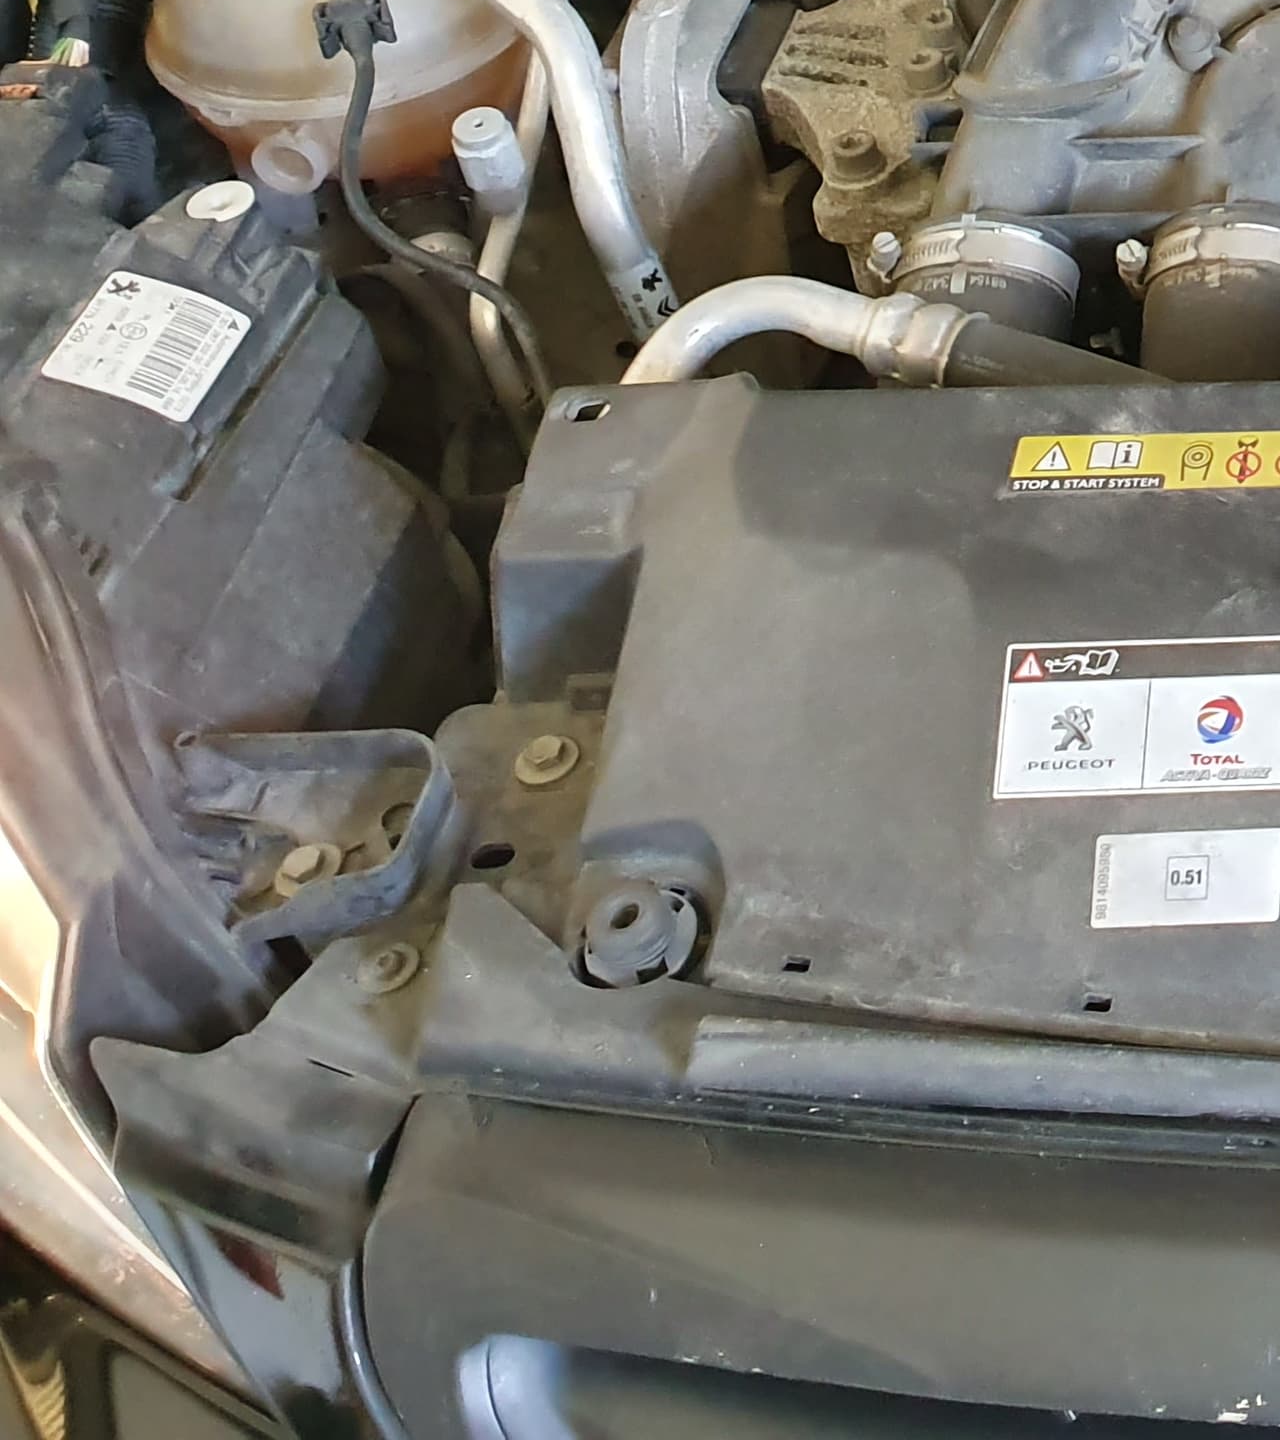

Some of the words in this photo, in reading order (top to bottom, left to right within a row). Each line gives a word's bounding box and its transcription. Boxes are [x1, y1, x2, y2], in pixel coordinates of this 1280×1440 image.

[1012, 479, 1050, 491] STOP
[1049, 479, 1061, 490] &
[1063, 478, 1107, 490] START
[1107, 477, 1161, 489] SYSTEM
[1027, 758, 1117, 771] PEUGEOT
[1170, 869, 1202, 886] 0.51
